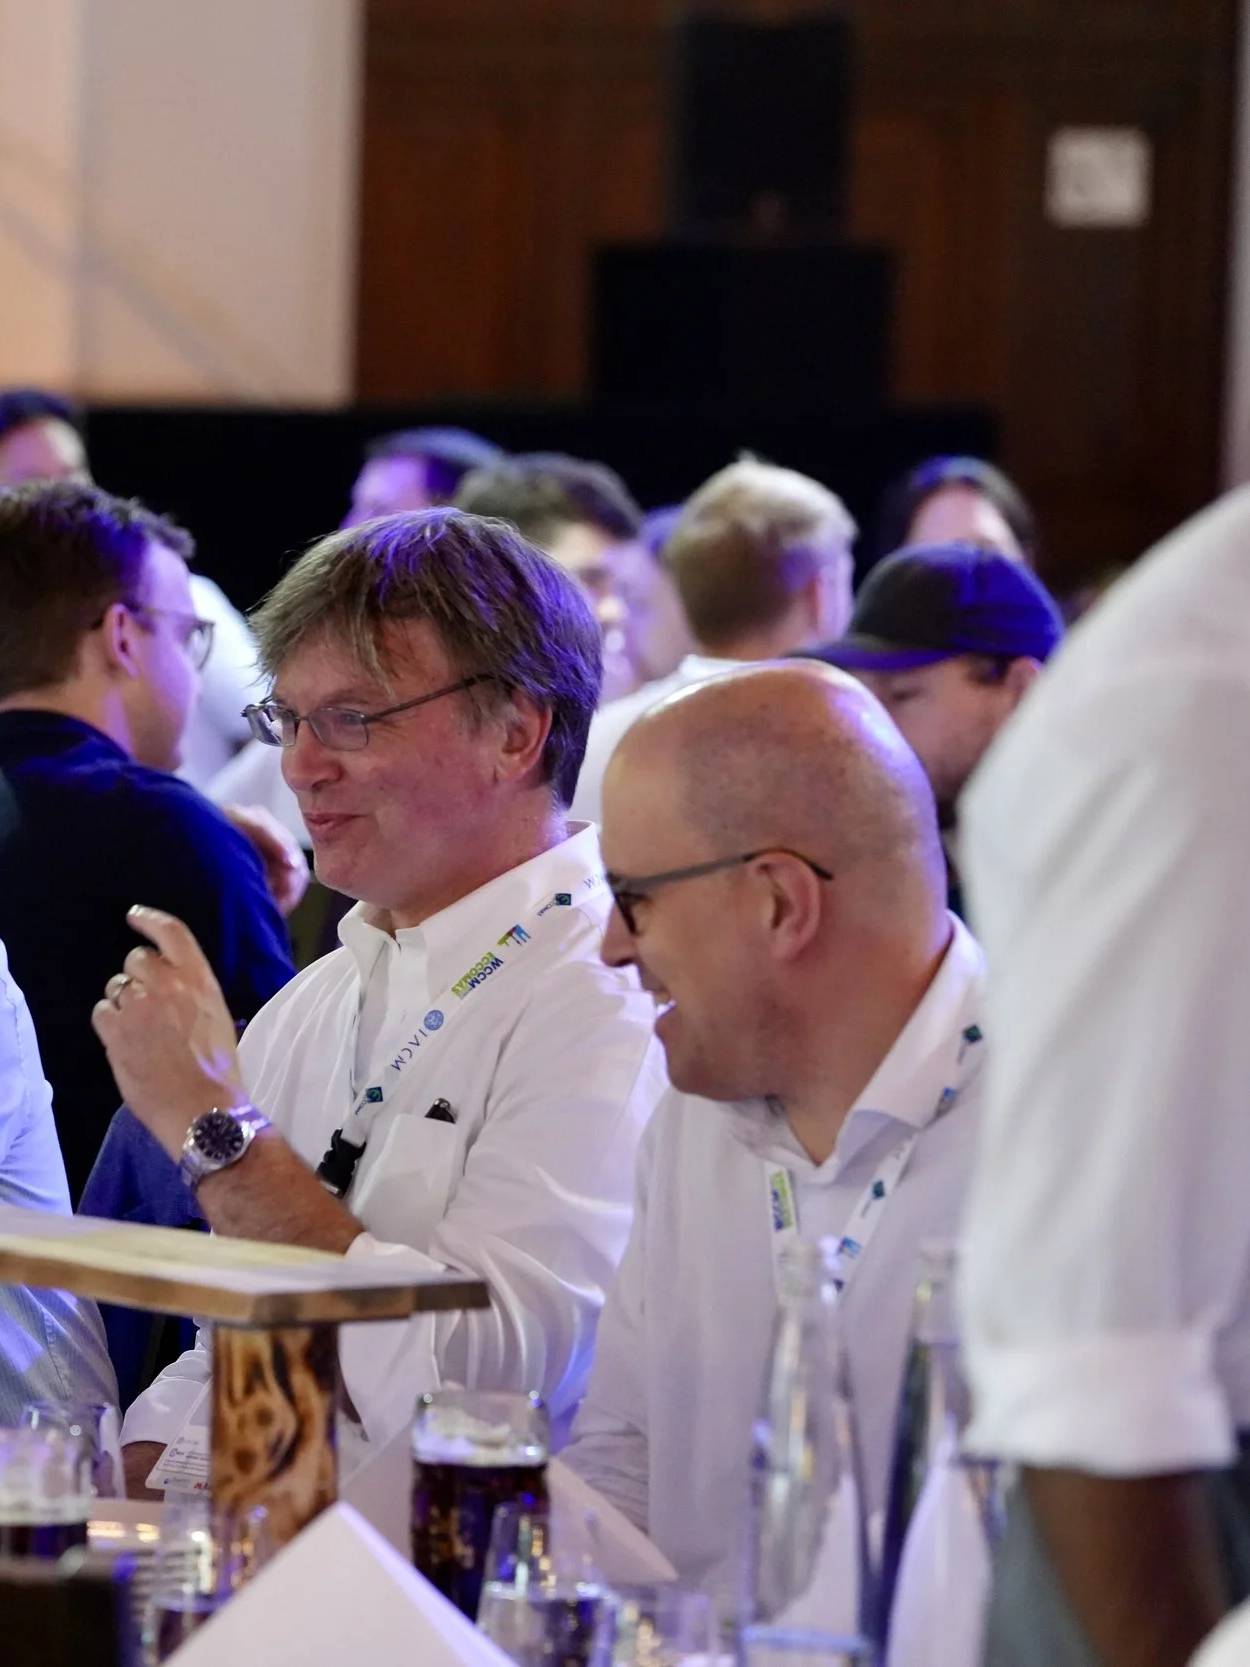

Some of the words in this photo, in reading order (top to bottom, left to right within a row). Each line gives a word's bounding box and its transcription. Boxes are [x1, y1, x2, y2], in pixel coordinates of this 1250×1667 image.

[451, 951, 495, 997] ECCOMAS
[468, 957, 504, 988] WCCM
[390, 1028, 428, 1071] IACM
